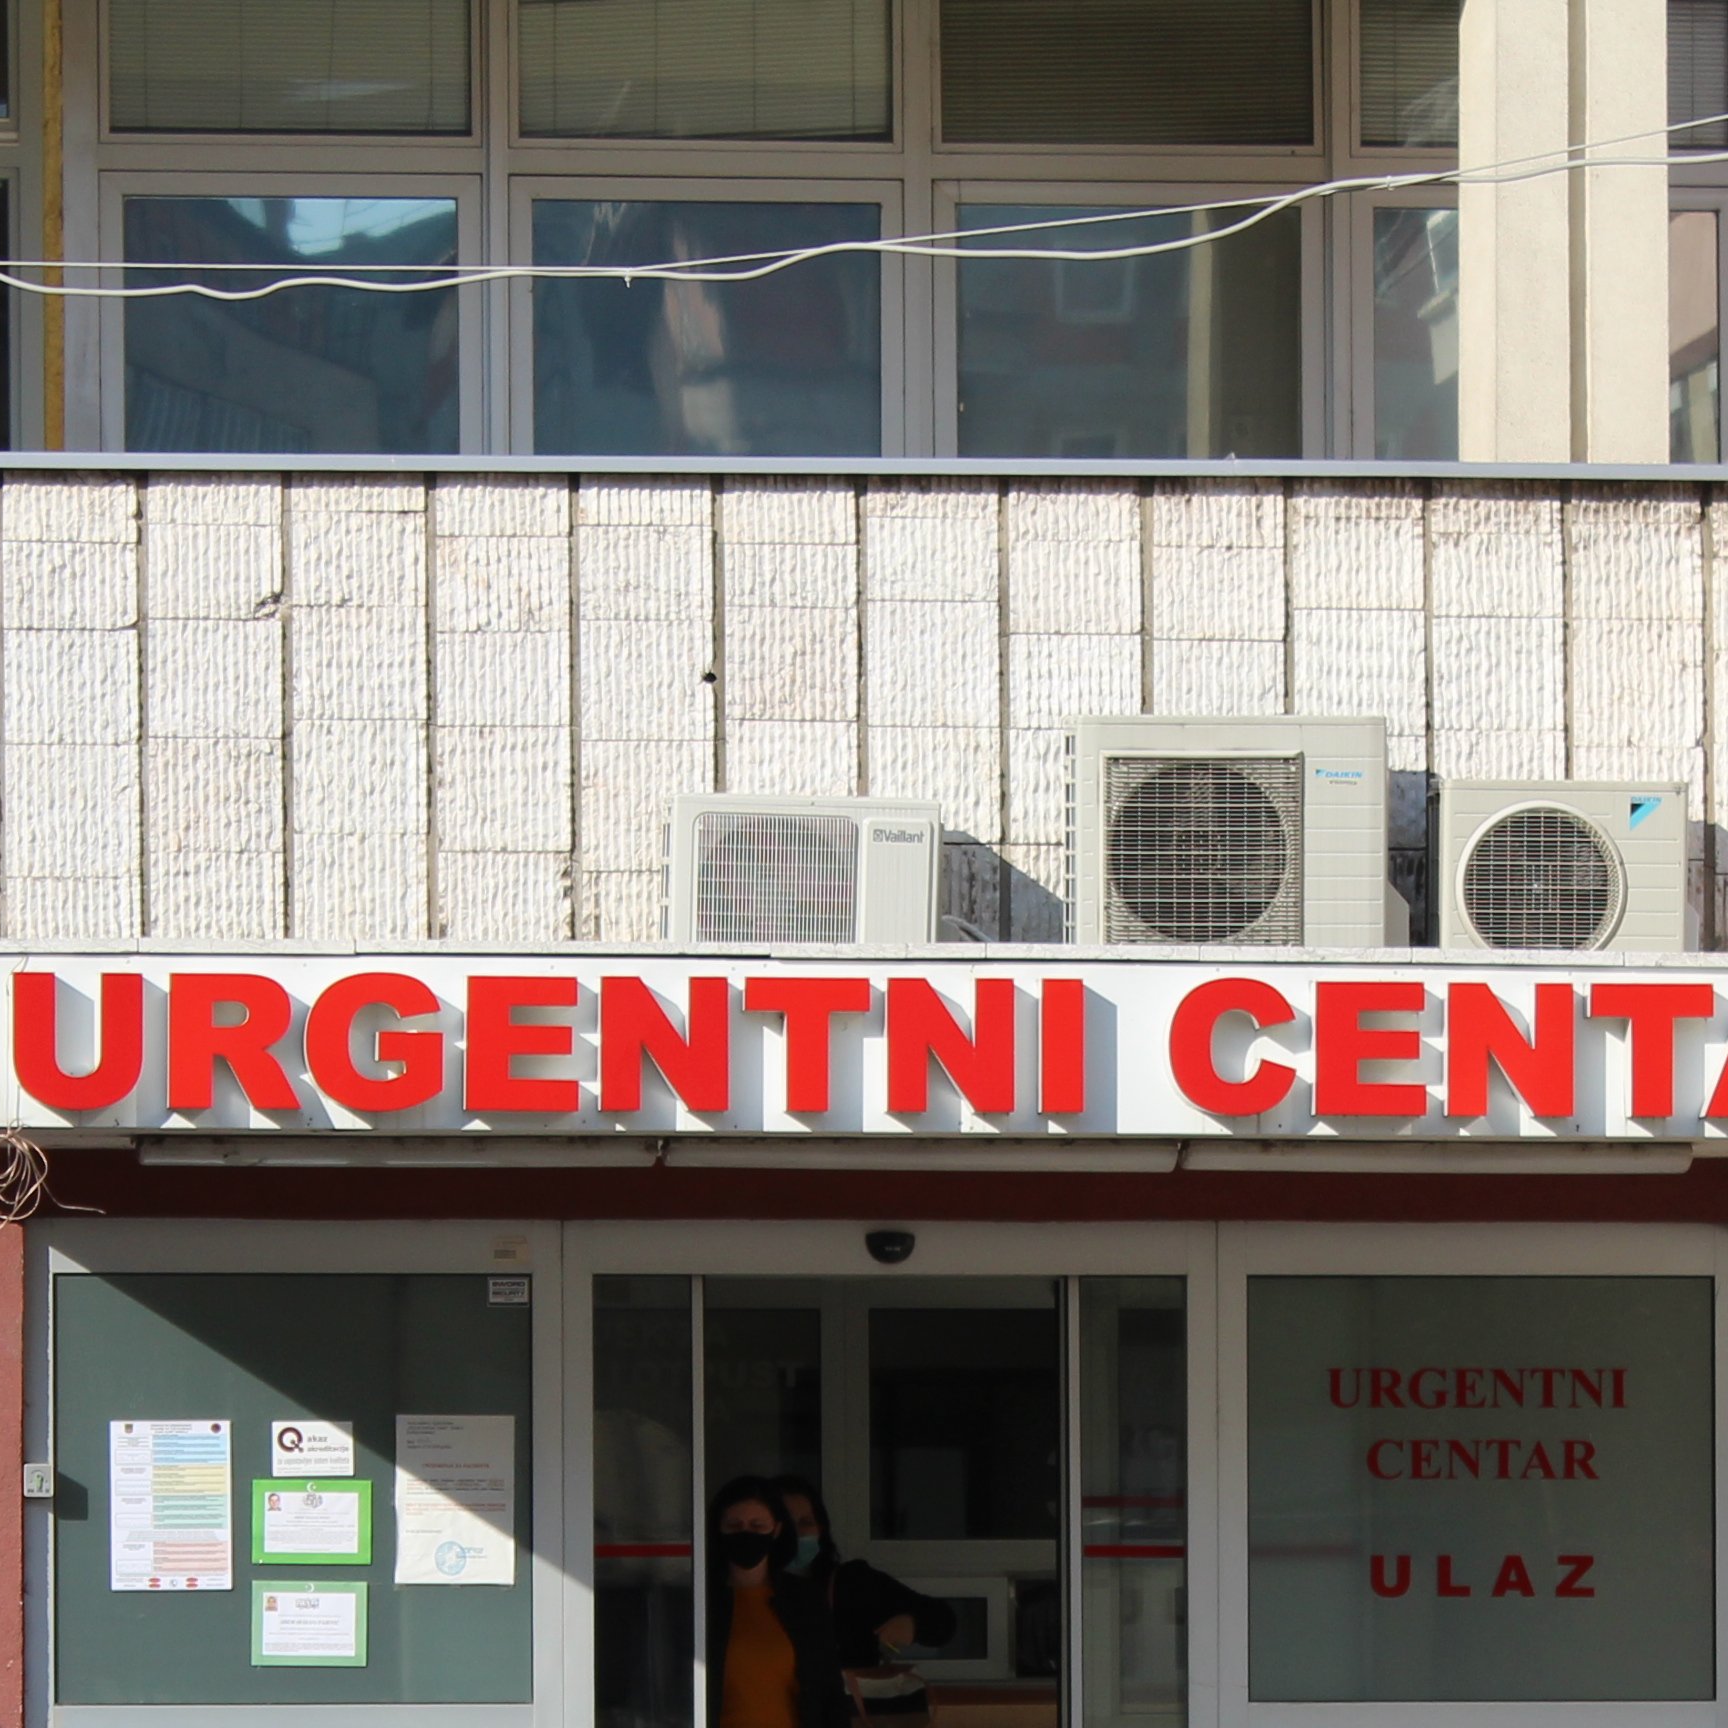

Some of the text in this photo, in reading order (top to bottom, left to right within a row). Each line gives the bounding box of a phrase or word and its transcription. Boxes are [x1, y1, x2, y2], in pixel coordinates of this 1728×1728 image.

[883, 829, 925, 843] Vaillant
[12, 971, 1083, 1115] URGENTNI
[1327, 1367, 1628, 1409] URGENTNI
[1366, 1438, 1600, 1480] CENTAR
[1369, 1555, 1595, 1598] ULAZ
